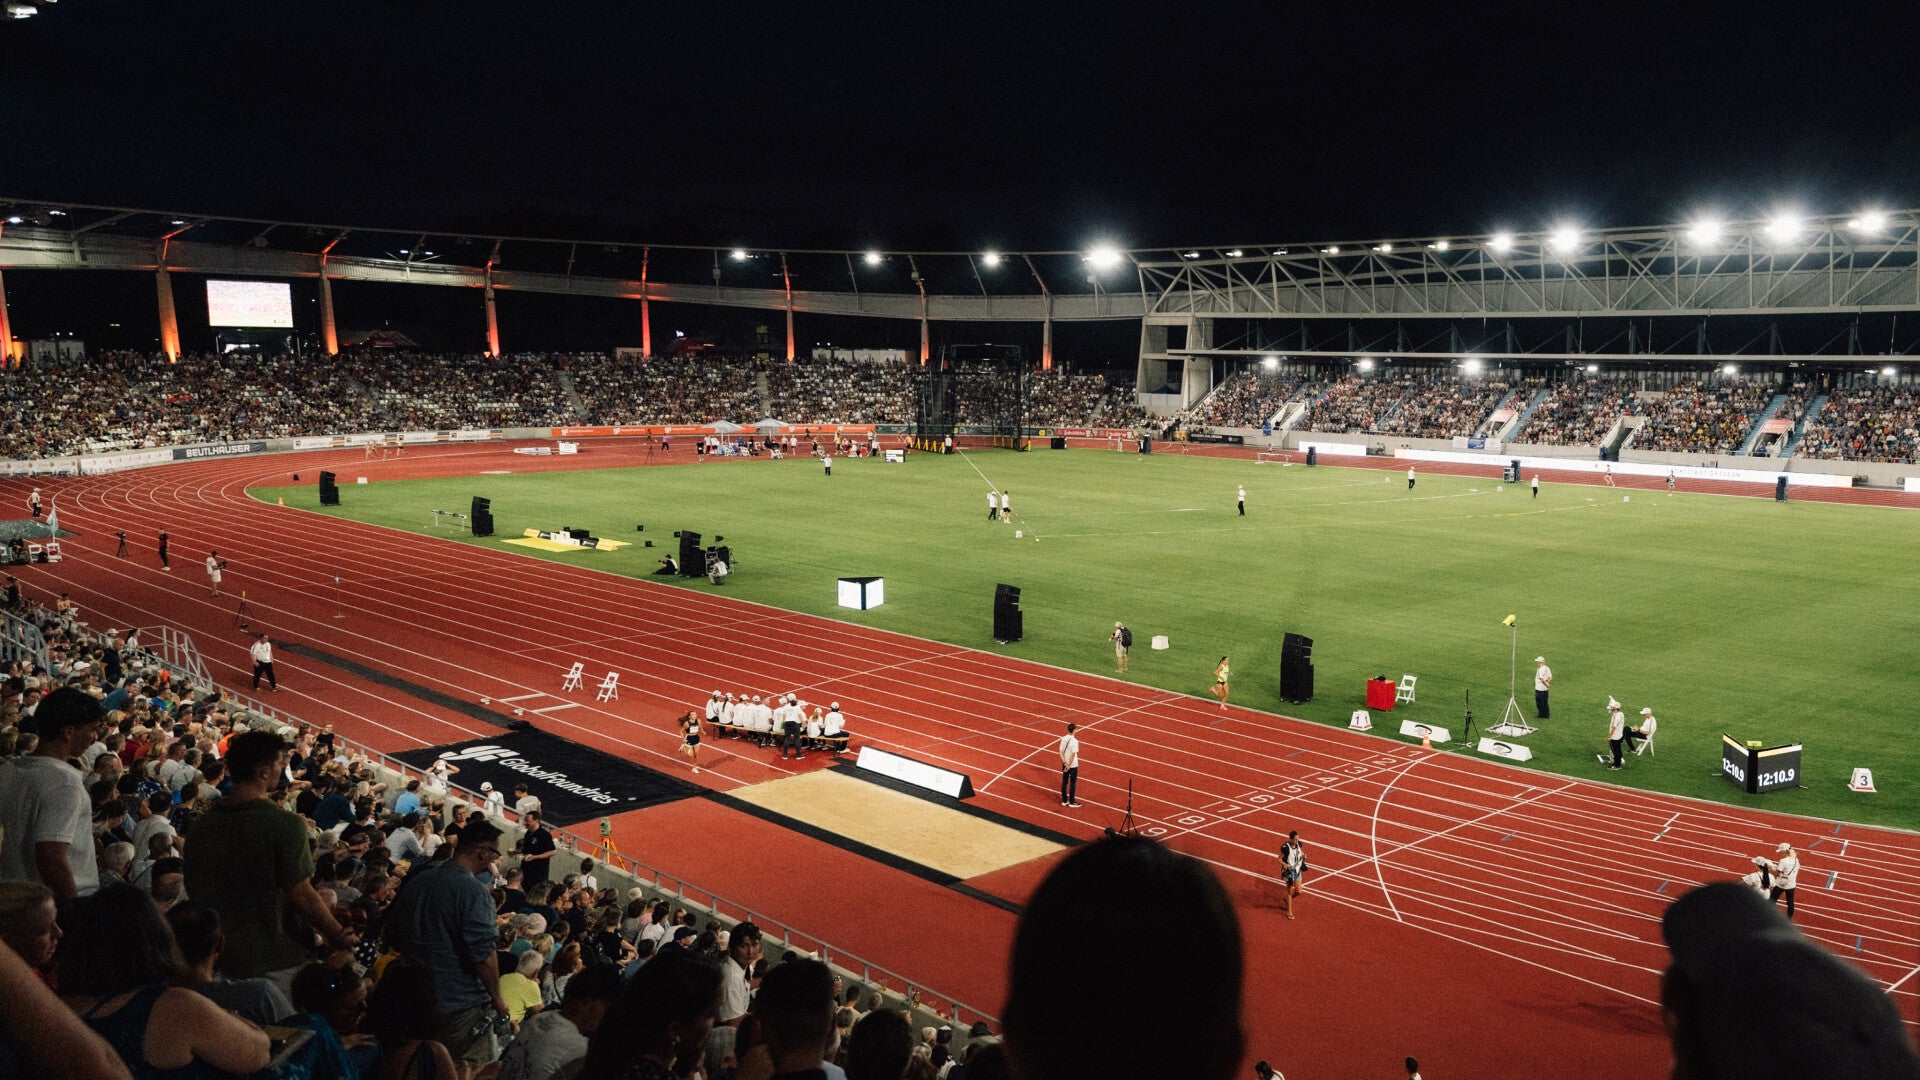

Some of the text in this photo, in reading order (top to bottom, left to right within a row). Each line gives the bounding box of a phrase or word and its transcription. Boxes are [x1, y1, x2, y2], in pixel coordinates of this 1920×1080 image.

[186, 444, 251, 457] BEUTLHAUSER
[1372, 757, 1397, 766] 2
[1343, 766, 1369, 775] 3
[1723, 757, 1745, 782] 12:10.9
[498, 757, 619, 805] GlobalFoundries
[1316, 776, 1340, 784] 4
[1757, 768, 1795, 787] 12:10.9
[1860, 775, 1868, 786] 3
[1282, 784, 1310, 793] 5
[1249, 794, 1275, 803] 6
[1217, 804, 1242, 813] 7
[1177, 815, 1206, 825] 8
[1140, 827, 1168, 837] 9
